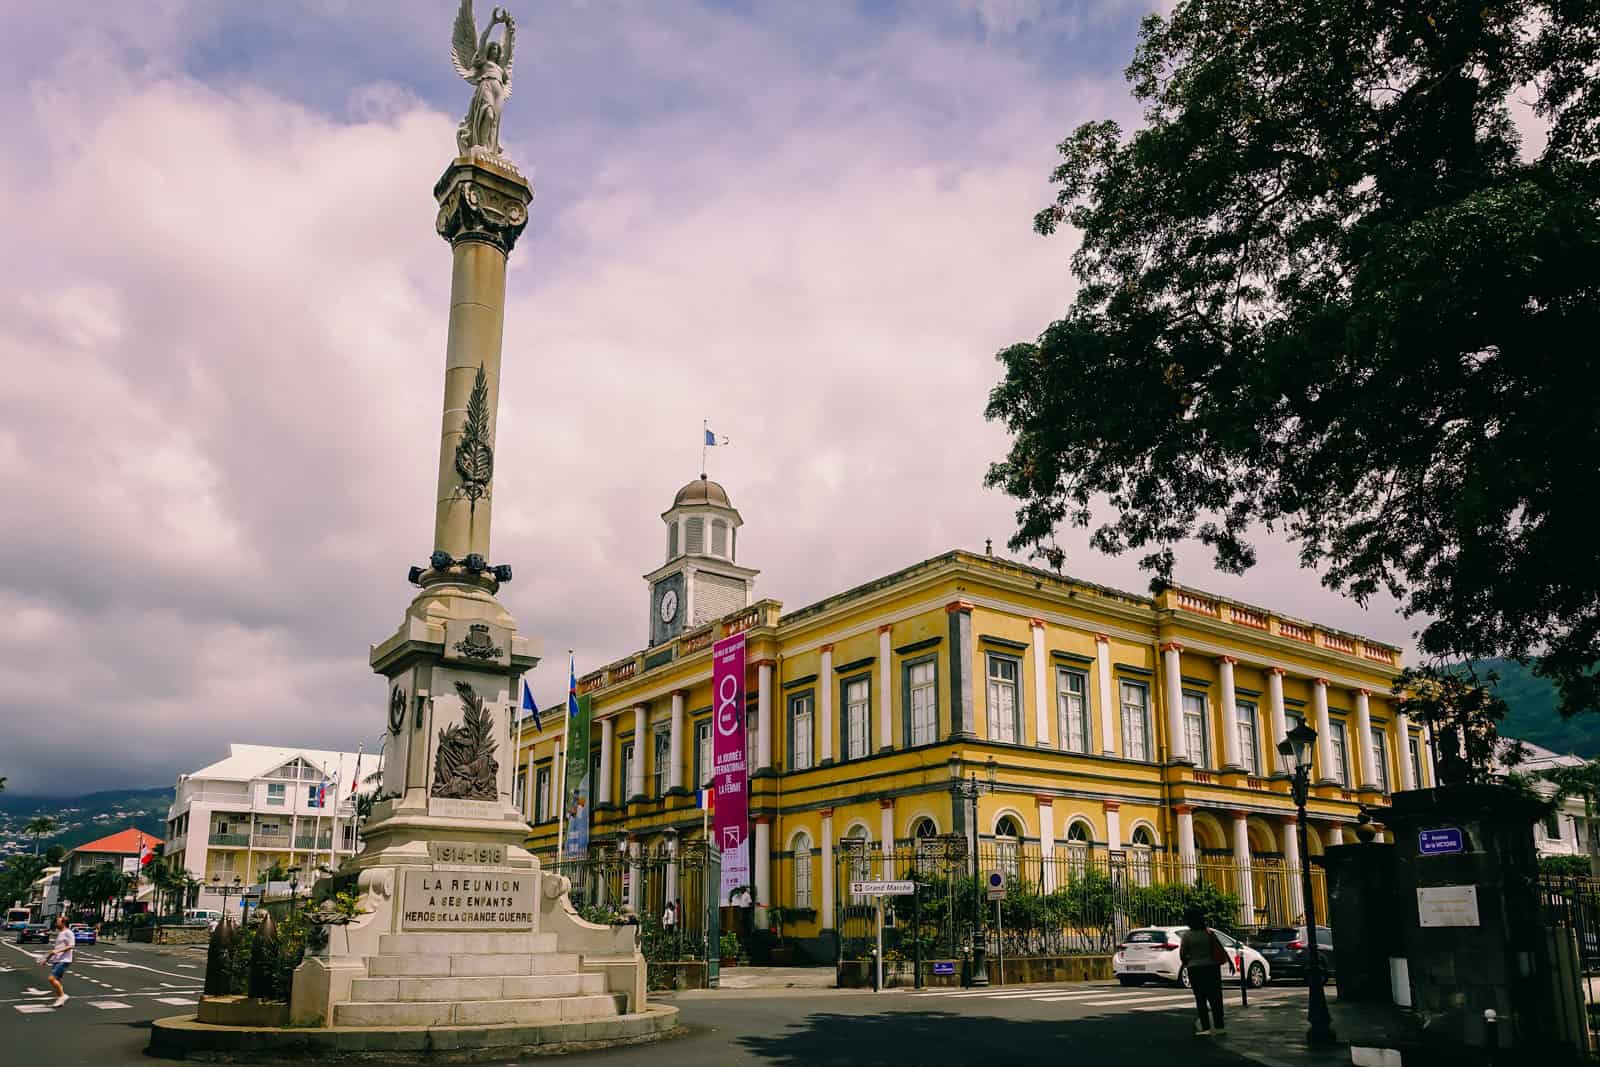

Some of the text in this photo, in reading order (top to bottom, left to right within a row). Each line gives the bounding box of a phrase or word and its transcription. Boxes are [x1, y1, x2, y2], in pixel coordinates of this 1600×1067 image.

[718, 674, 738, 736] 8
[725, 774, 732, 784] DE
[725, 781, 741, 794] FEMME
[423, 879, 520, 892] LA REUNION
[428, 896, 513, 908] A SES ENFANTS
[405, 911, 533, 923] HEROS DE LA GRANDE GUERRE
